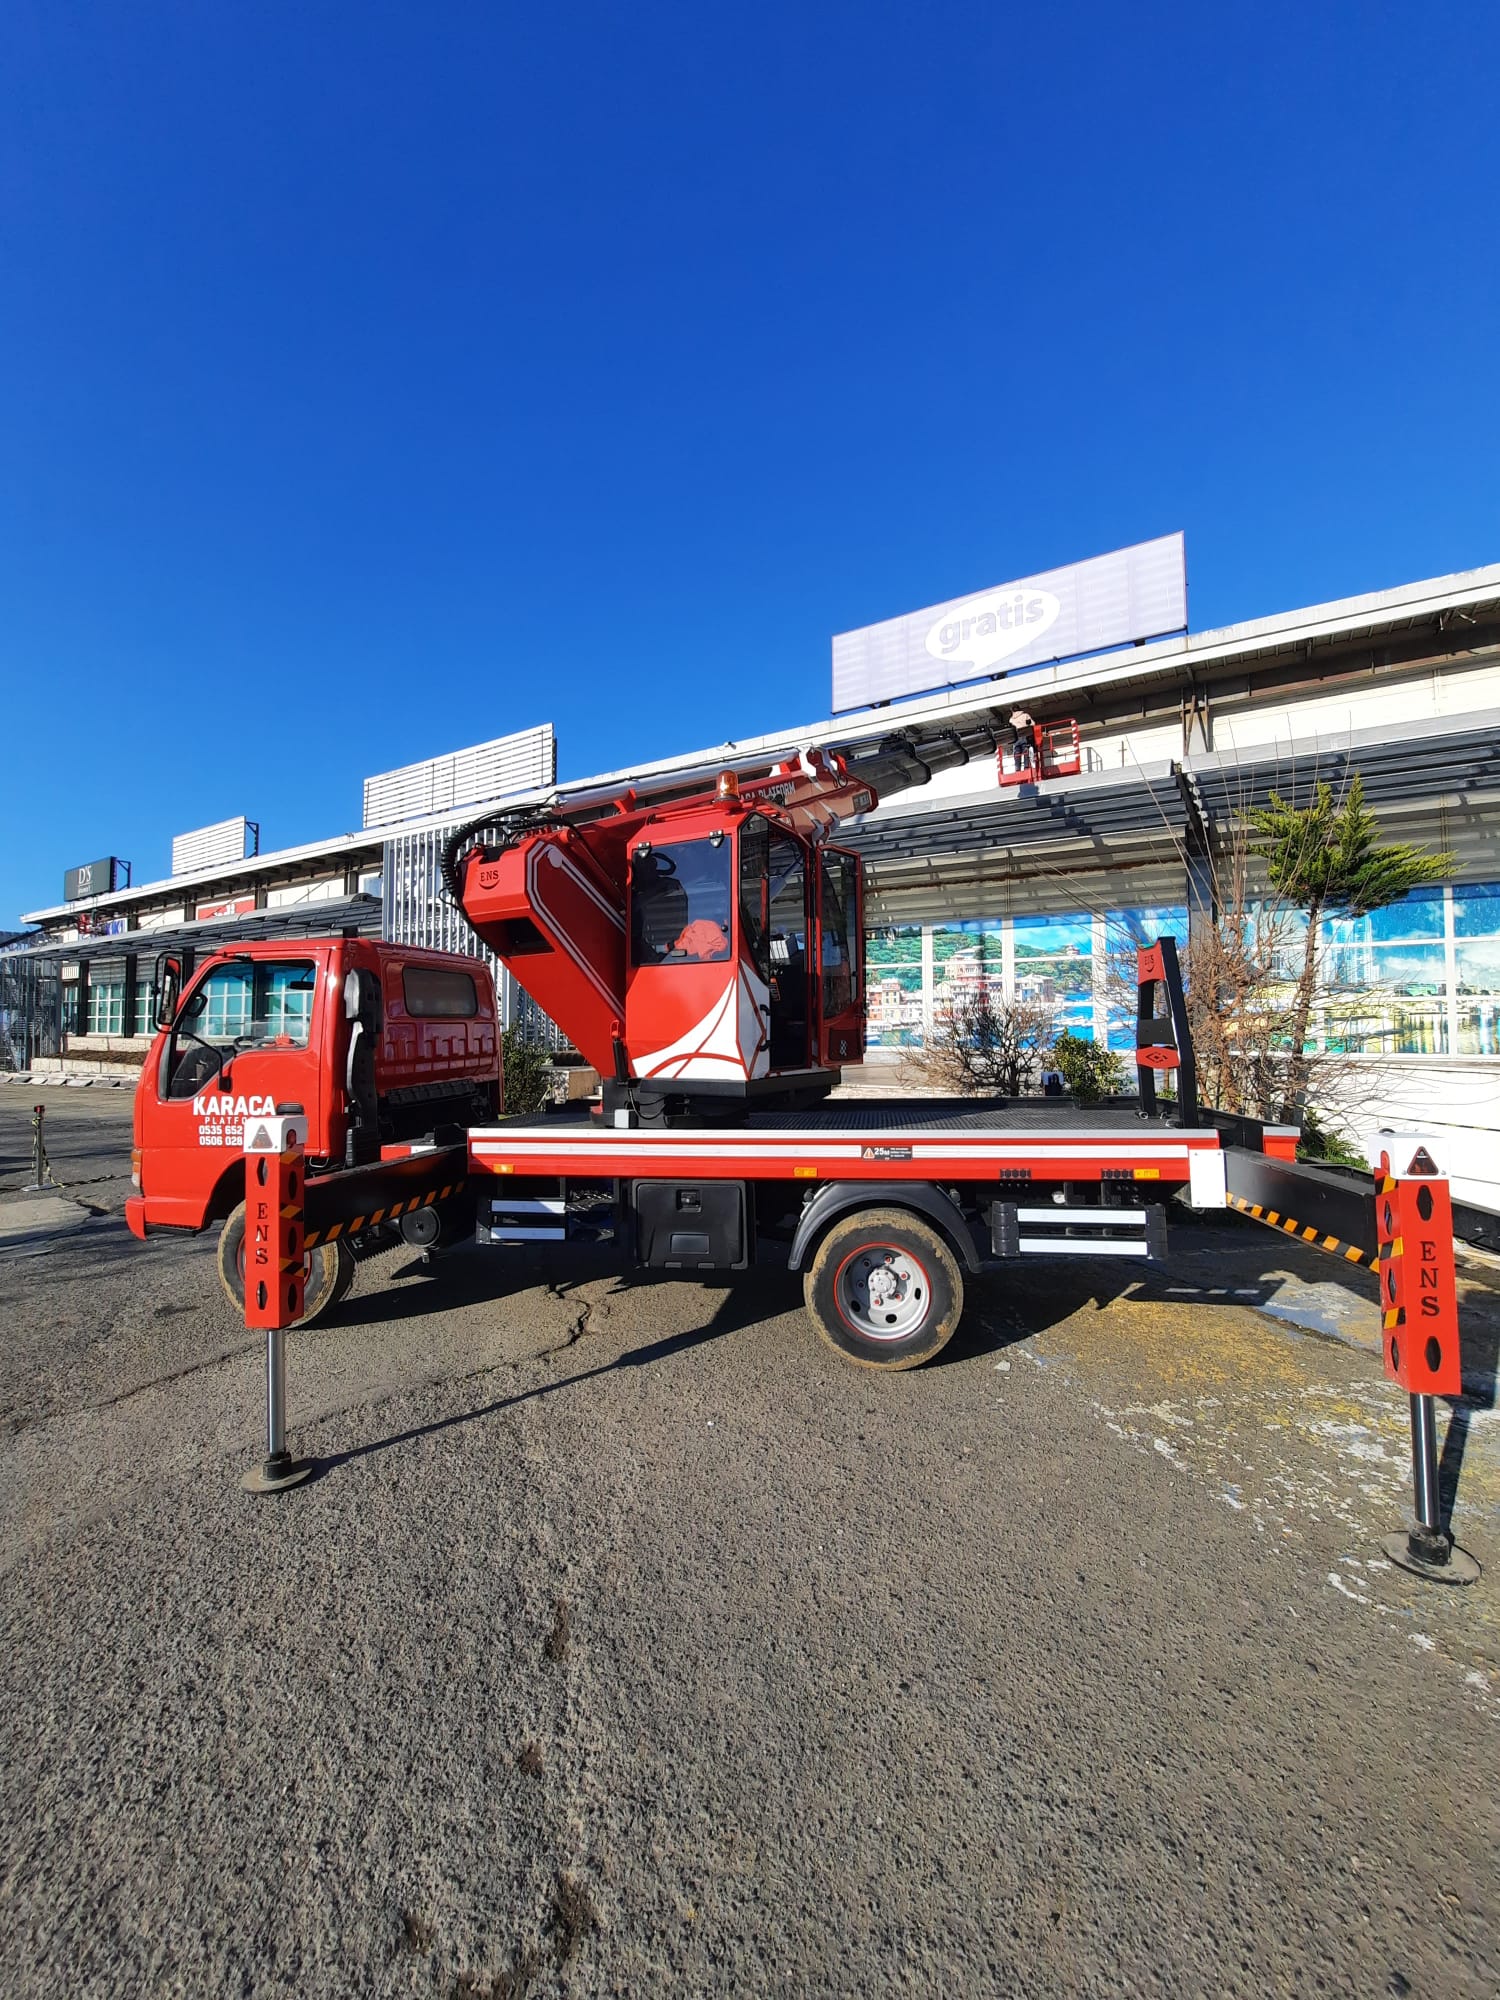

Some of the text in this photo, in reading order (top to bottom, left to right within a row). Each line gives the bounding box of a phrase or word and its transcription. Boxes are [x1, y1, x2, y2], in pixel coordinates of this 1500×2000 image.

[939, 595, 1044, 654] gratis
[480, 870, 499, 881] ENS
[193, 1095, 277, 1116] KARACA
[199, 1125, 243, 1135] 0535 652
[199, 1136, 243, 1146] 0506 028
[256, 1203, 269, 1264] ENS
[1419, 1241, 1440, 1316] ENS
